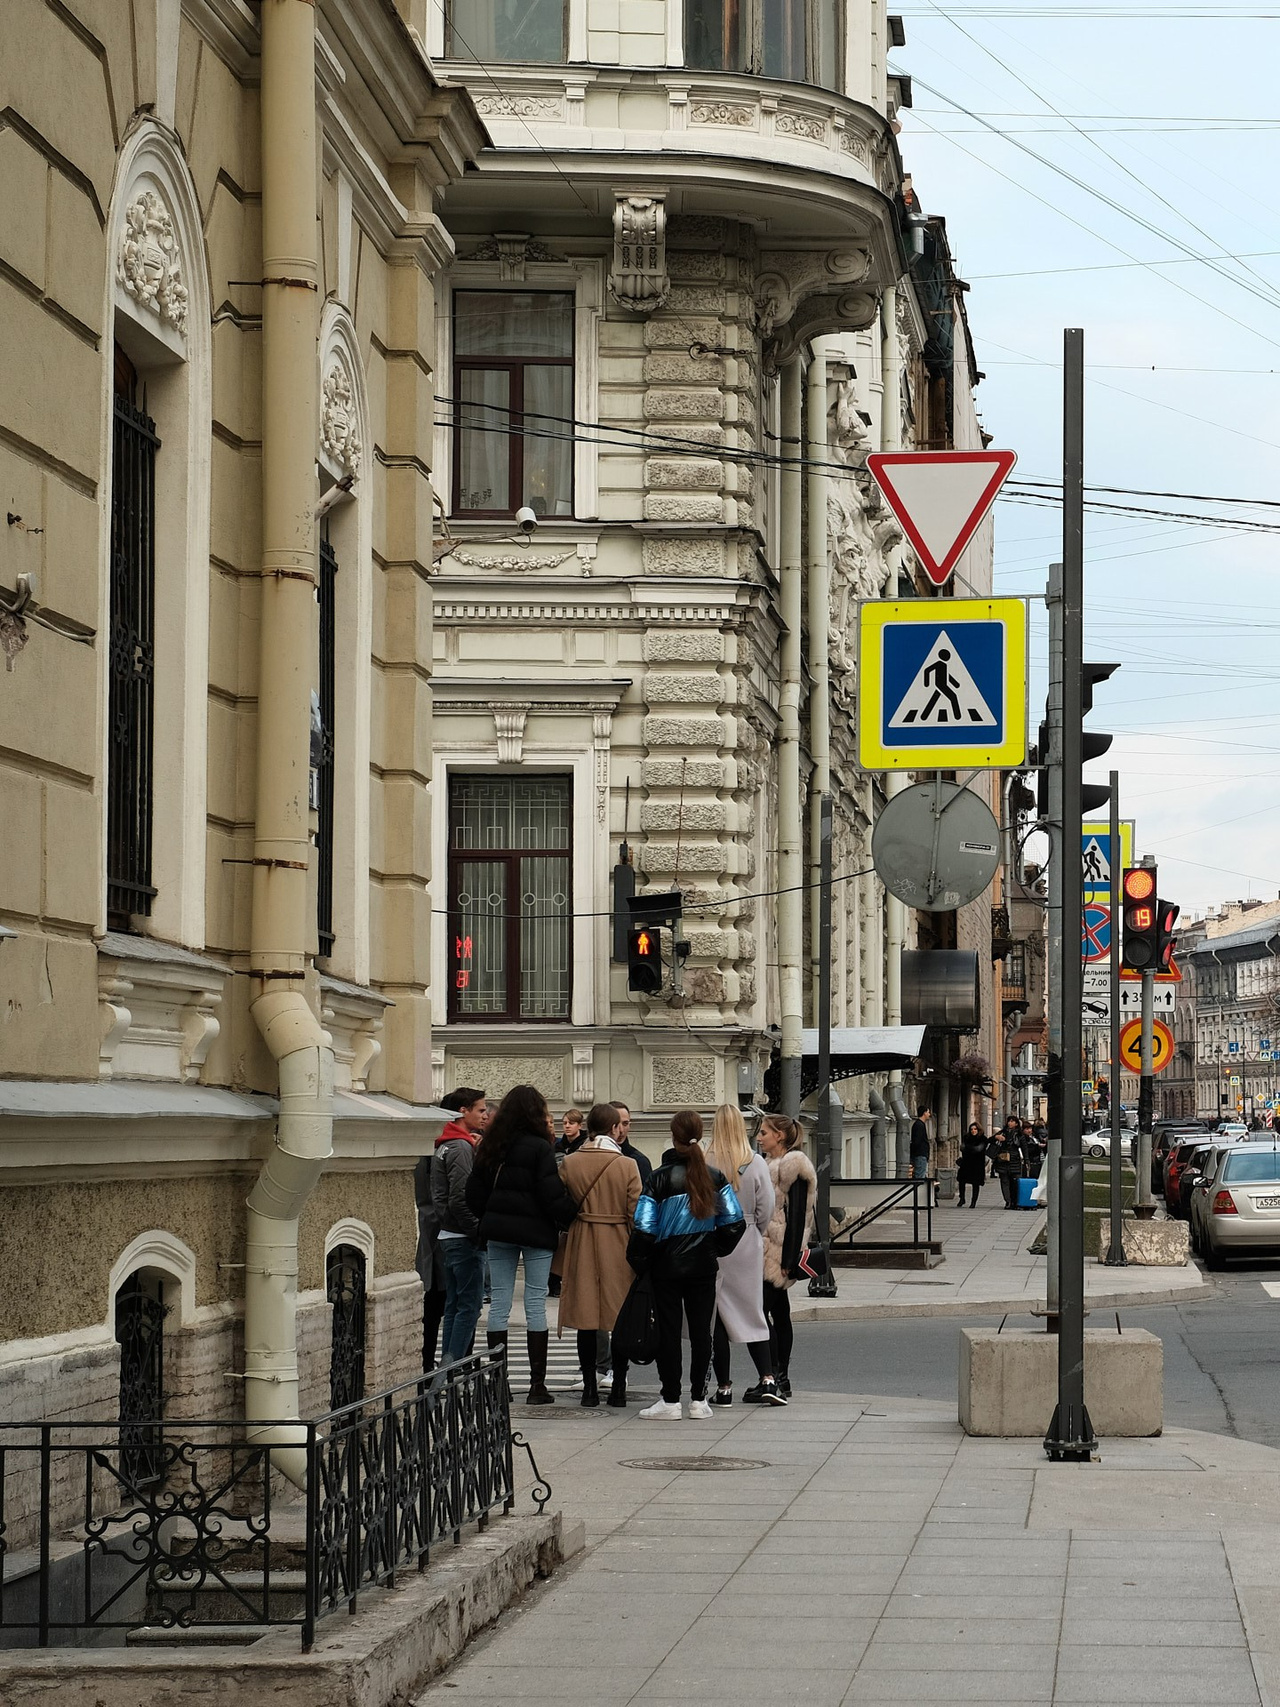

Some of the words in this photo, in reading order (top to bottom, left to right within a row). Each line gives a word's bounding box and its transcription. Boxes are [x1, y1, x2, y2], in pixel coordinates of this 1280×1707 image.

[1137, 909, 1151, 927] 19
[1132, 992, 1162, 1003] 35м
[1127, 1034, 1162, 1058] 40
